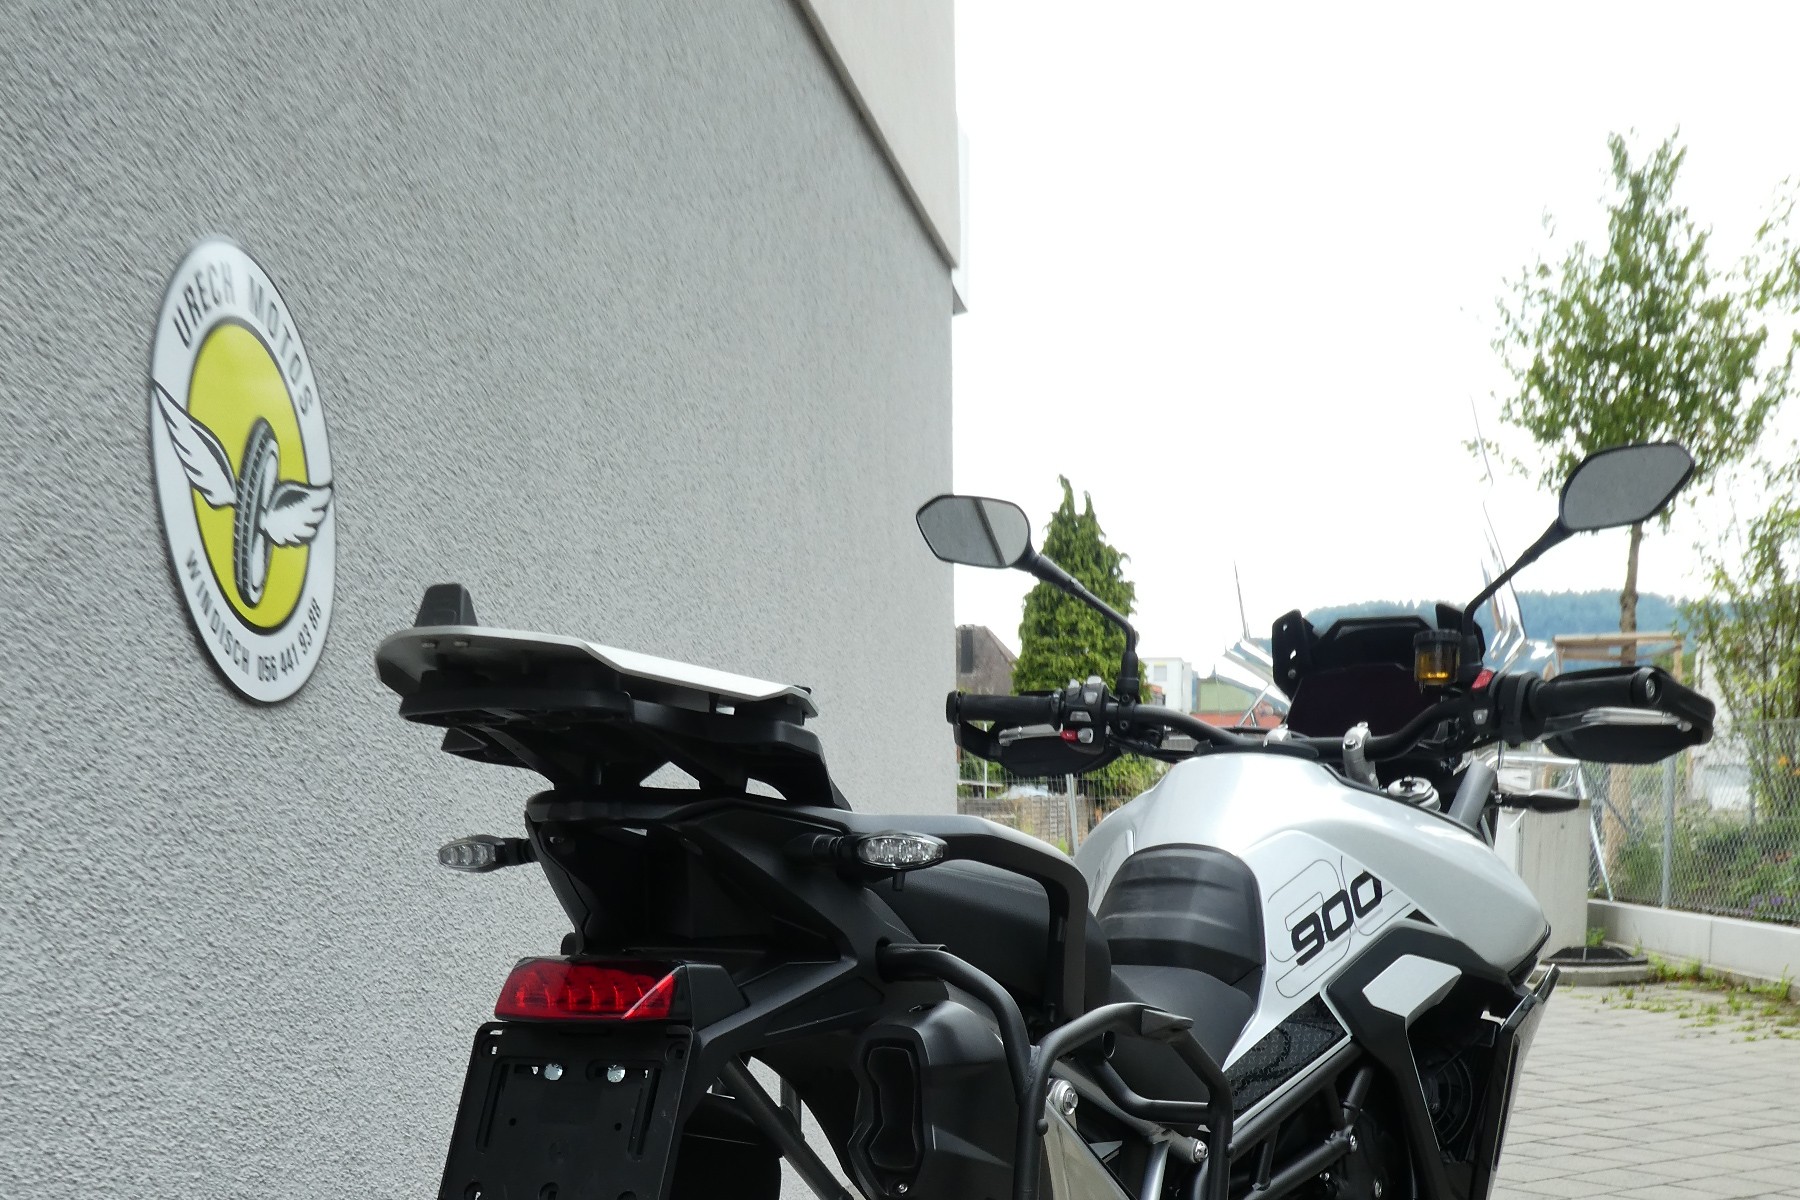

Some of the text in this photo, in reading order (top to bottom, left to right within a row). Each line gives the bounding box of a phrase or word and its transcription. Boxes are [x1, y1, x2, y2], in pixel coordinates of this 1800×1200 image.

[172, 261, 314, 417] URECH MOTOS
[185, 548, 322, 682] WINDISCH 056 441 93 88
[1290, 870, 1383, 967] 900
